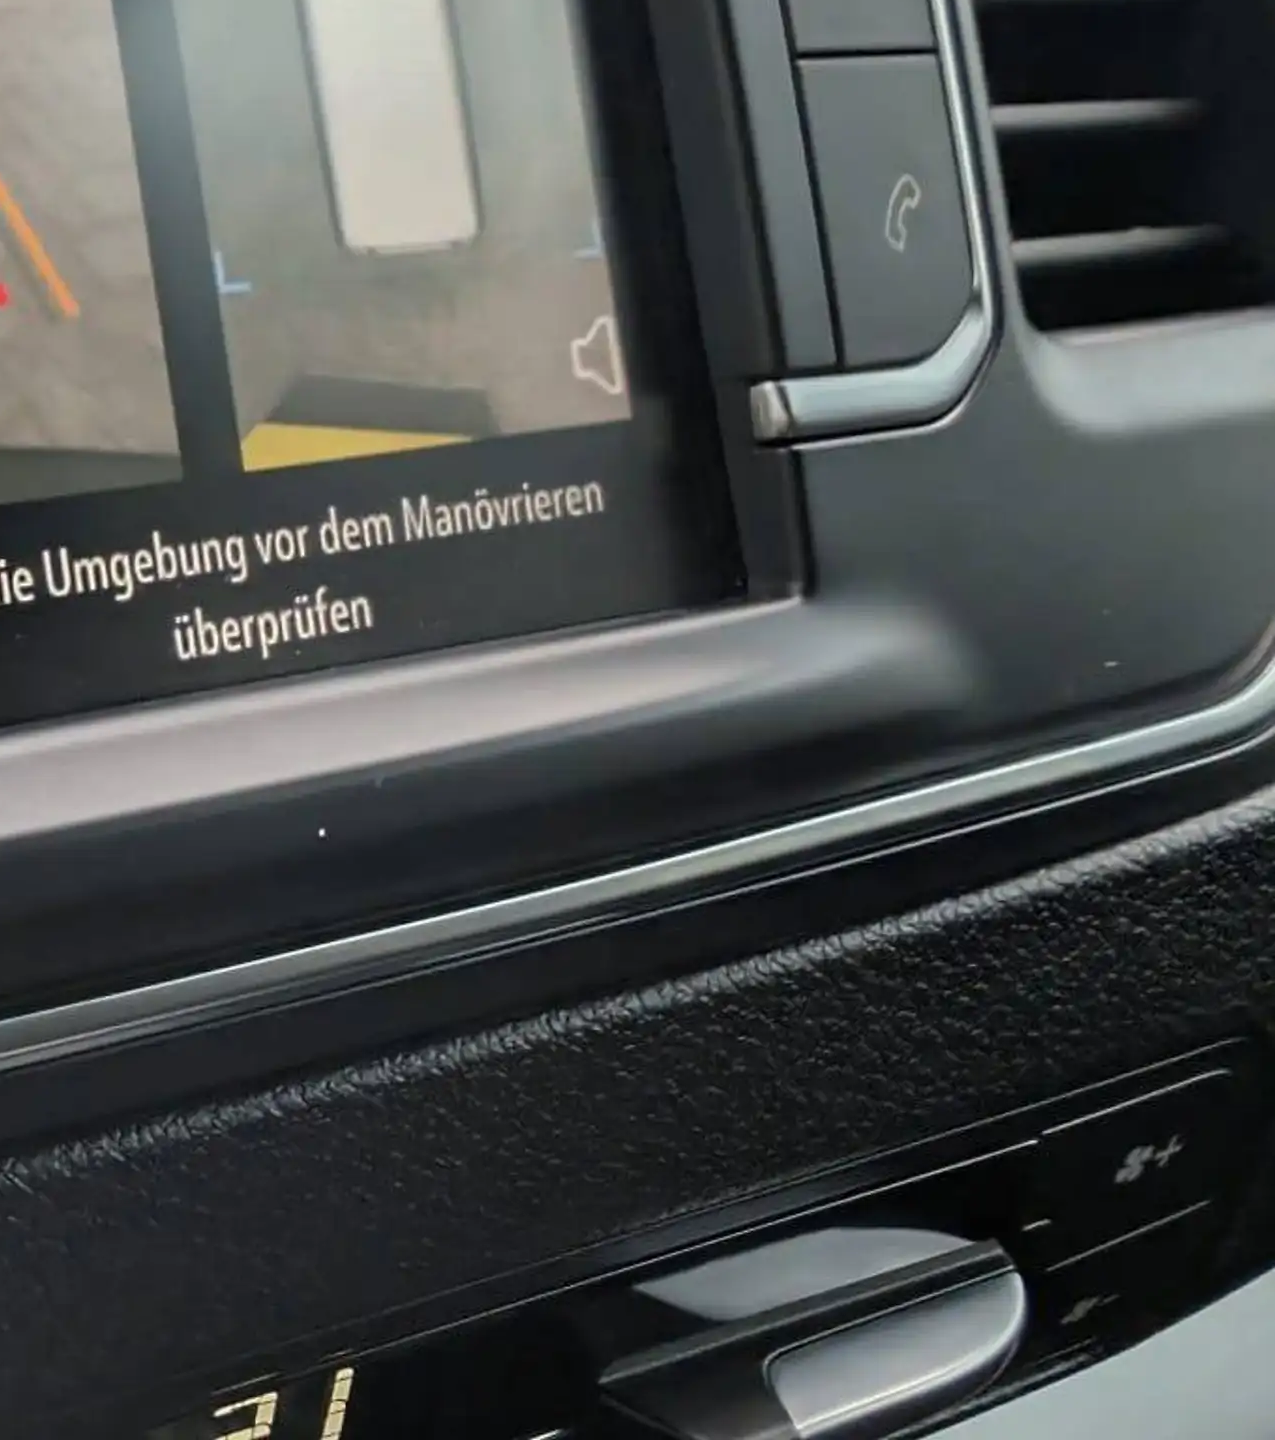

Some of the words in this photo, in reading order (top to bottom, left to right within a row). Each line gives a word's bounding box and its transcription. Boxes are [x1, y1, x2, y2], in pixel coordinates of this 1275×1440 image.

[40, 529, 250, 603] Umgebung
[253, 524, 310, 565] vor
[317, 503, 397, 556] dem
[400, 478, 606, 544] Manövrieren
[172, 586, 374, 661] überprüfen
